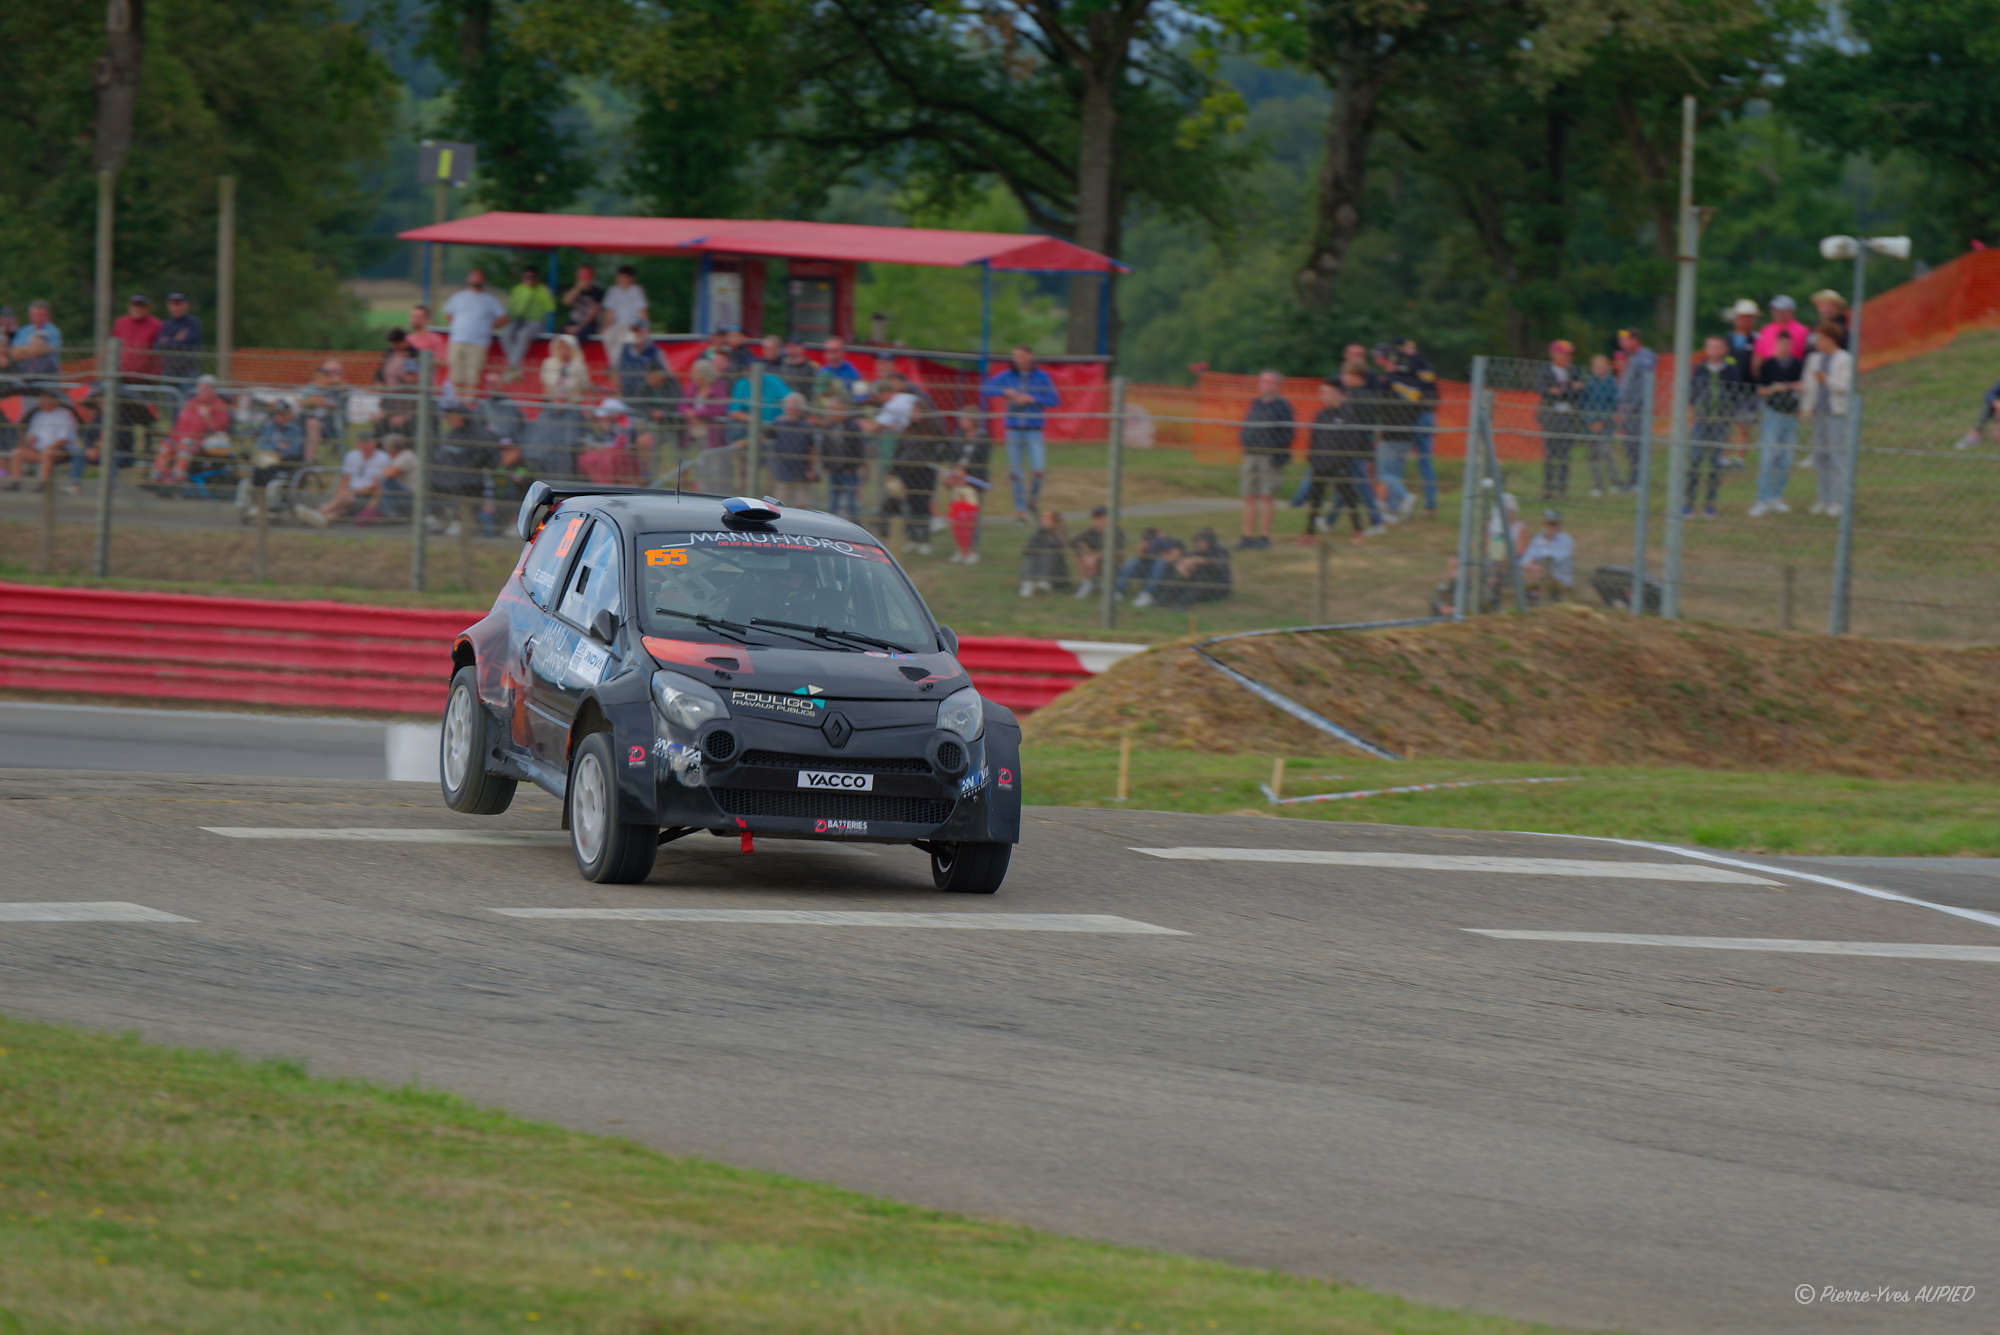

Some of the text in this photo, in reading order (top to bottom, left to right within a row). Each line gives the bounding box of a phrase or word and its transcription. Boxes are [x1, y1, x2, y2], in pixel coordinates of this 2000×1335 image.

[690, 532, 767, 545] MANU
[772, 536, 854, 553] HYDRO
[645, 549, 687, 566] 155
[732, 691, 814, 710] POULIGO
[732, 700, 775, 710] TRAVAUX
[776, 705, 816, 717] PUBLICS
[806, 773, 867, 788] YACCO
